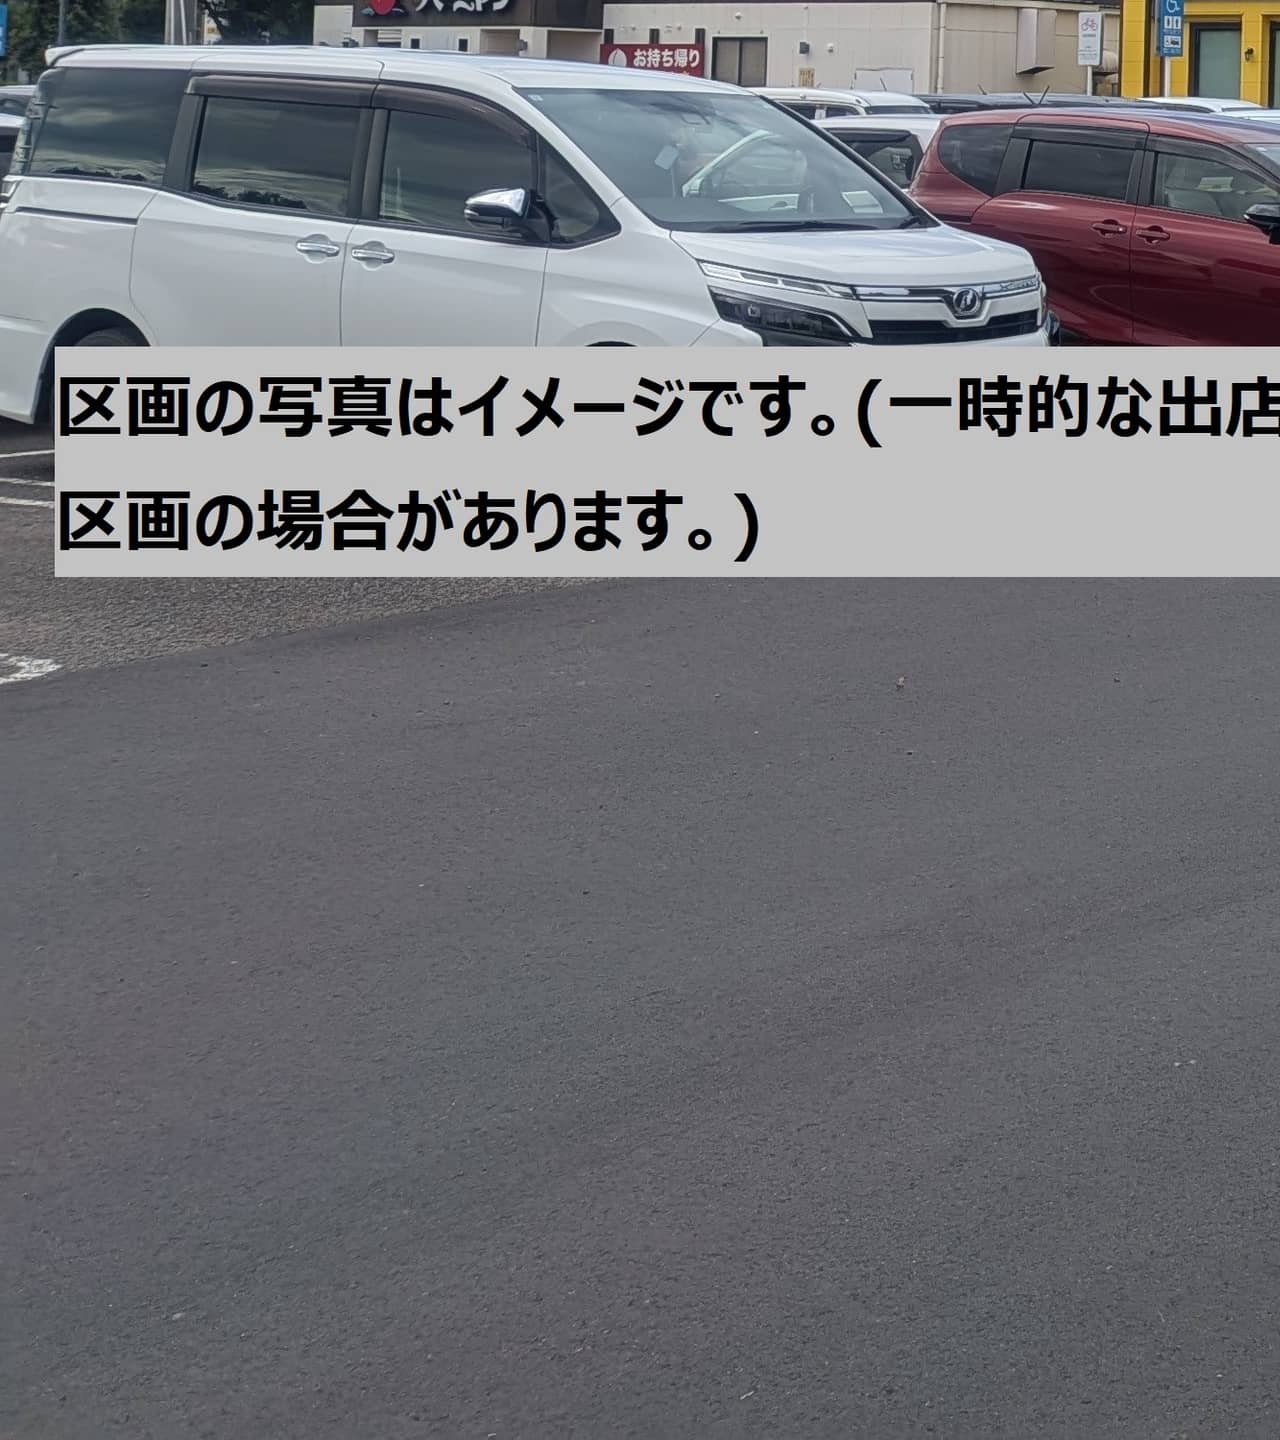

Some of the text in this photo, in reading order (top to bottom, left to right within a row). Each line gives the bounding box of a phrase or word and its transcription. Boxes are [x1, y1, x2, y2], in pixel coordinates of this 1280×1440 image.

[633, 47, 701, 68] お持ち帰り
